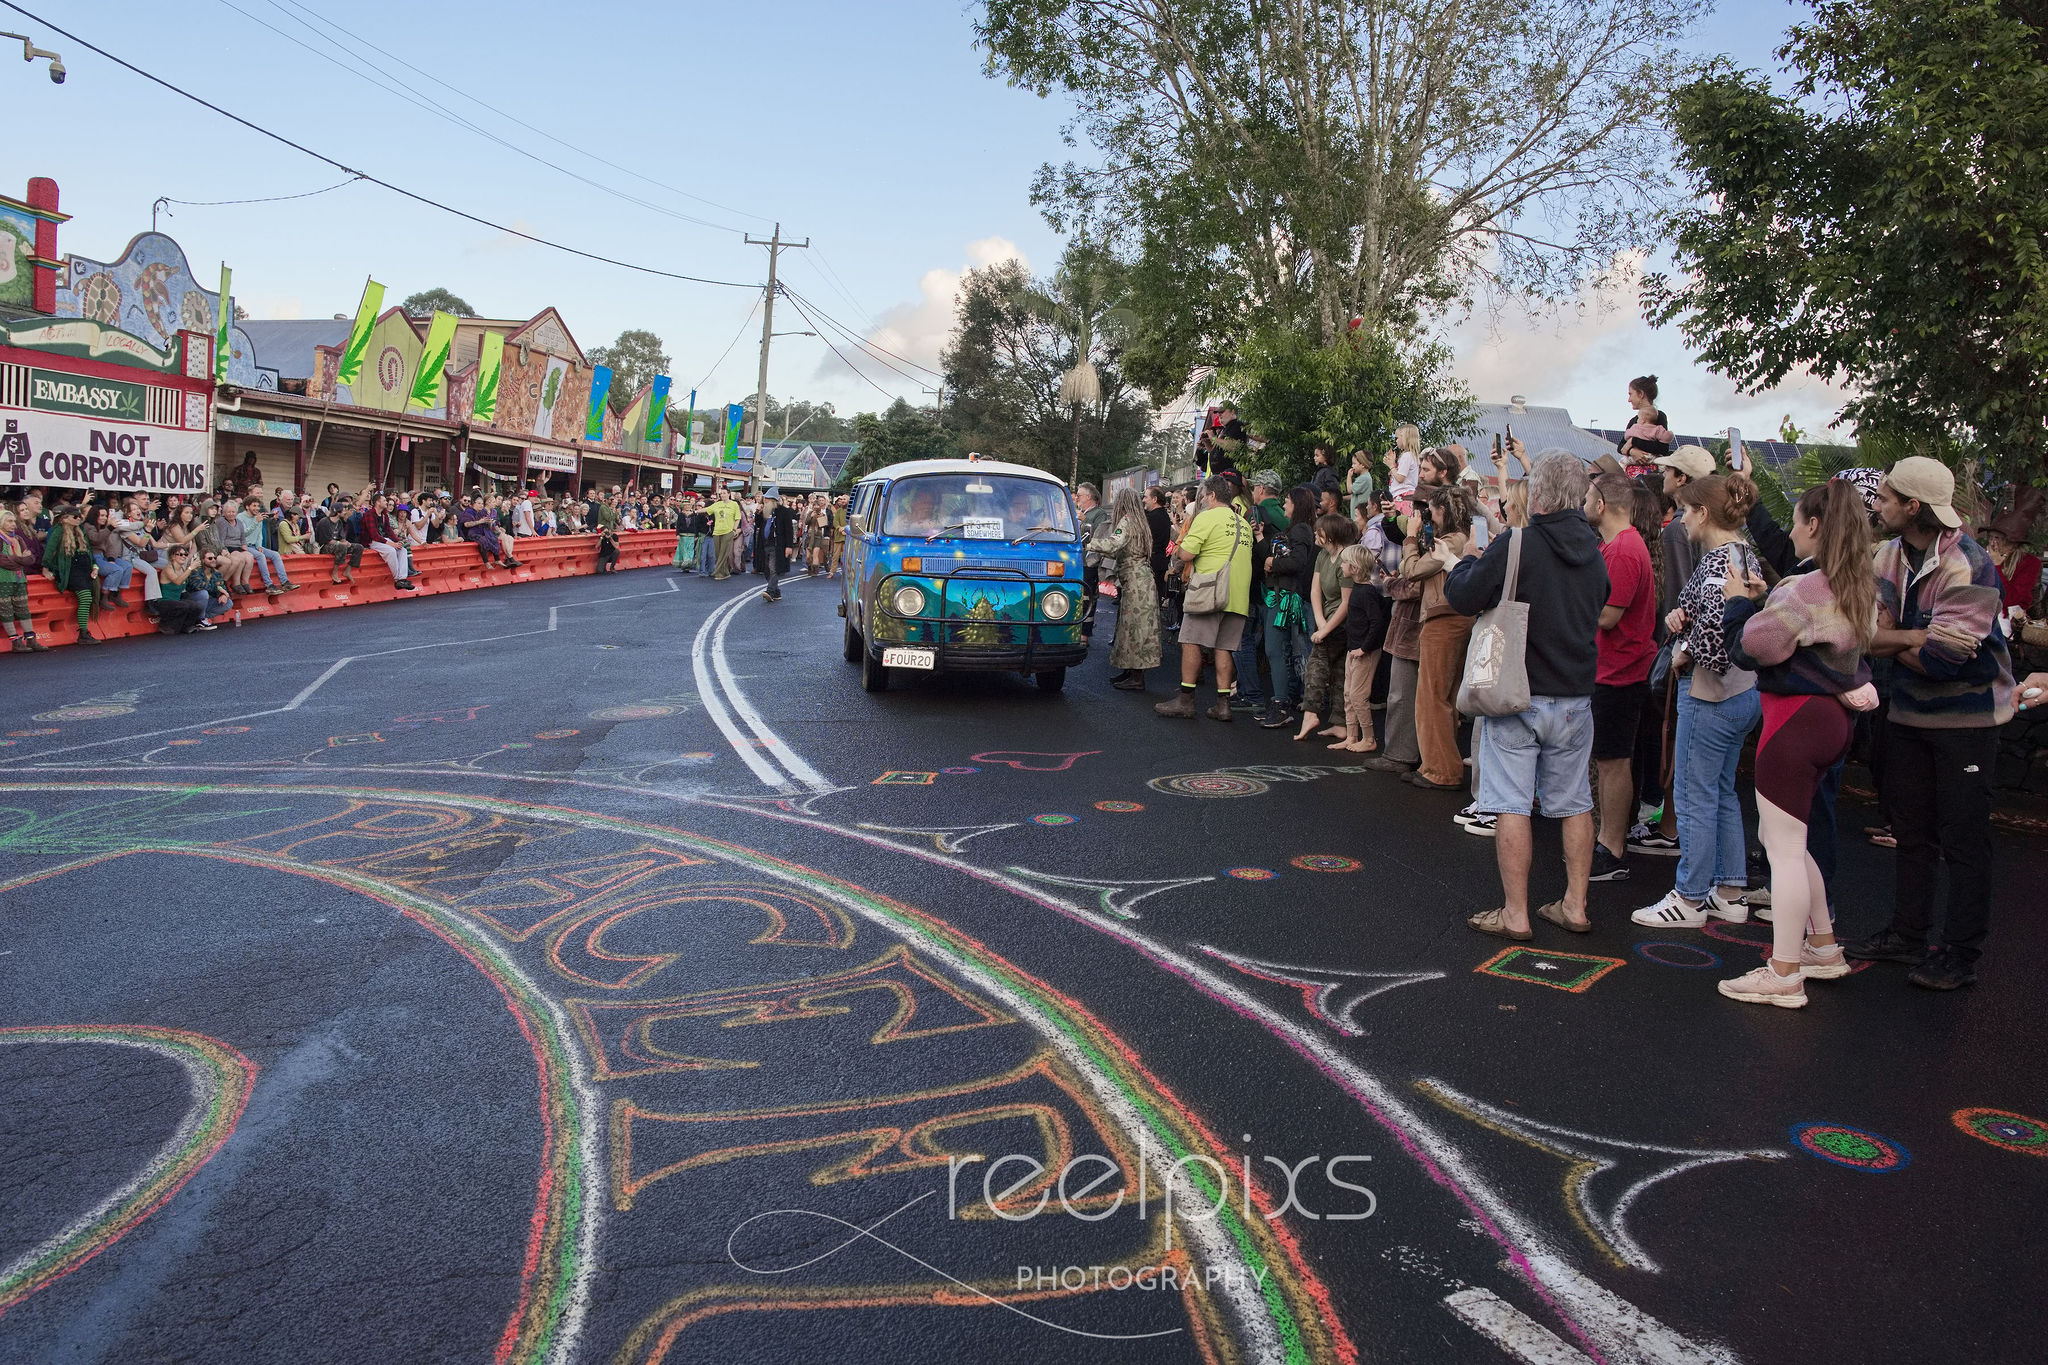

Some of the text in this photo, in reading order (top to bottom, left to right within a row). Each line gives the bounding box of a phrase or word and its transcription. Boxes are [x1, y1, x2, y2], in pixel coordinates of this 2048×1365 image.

[106, 335, 148, 354] LOCALLY
[34, 379, 122, 410] EMBASSY
[90, 429, 150, 458] NOT
[39, 450, 204, 490] CORPORATIONS
[966, 529, 1002, 538] SOMEWHERE
[890, 653, 931, 667] FOUR20
